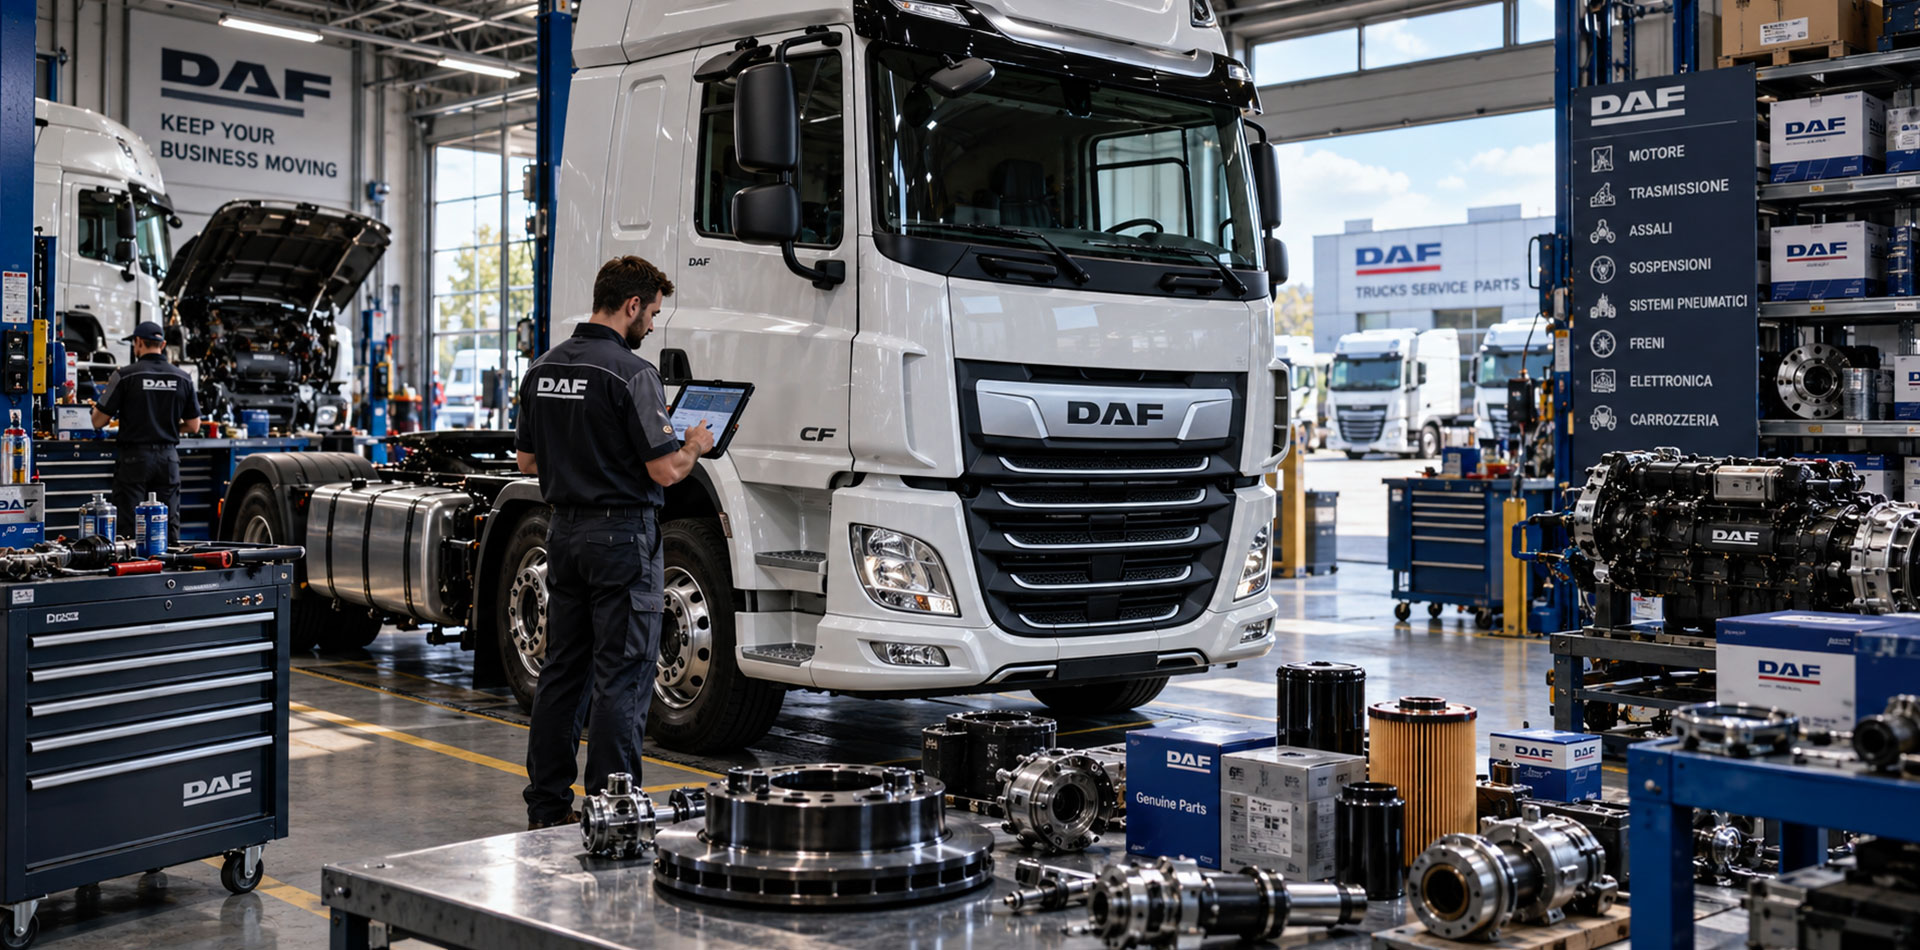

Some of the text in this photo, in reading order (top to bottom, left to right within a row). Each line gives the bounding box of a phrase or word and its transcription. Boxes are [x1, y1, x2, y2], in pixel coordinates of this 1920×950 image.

[161, 47, 332, 102] DAF
[1591, 85, 1685, 117] DAF
[160, 112, 275, 145] KEEP YOUR
[1786, 117, 1846, 136] DAF
[160, 140, 338, 178] BUSINESS MOVING
[1629, 145, 1685, 162] MOTORE
[1629, 178, 1729, 200] TRASMISSIONE
[1629, 222, 1672, 236] ASSALI
[1356, 243, 1442, 266] DAF
[1786, 241, 1848, 258] DAF
[689, 257, 711, 267] DAF
[1629, 257, 1712, 274] SOSPENSIONI
[1356, 278, 1520, 299] TRUCKS SERVICE PARTS
[1629, 294, 1748, 312] SISTEMI PNEUMATICI
[1629, 336, 1665, 350] FRENI
[142, 379, 178, 391] DAF
[537, 377, 588, 394] DAF
[1629, 374, 1713, 388] ELETTRONICA
[1067, 400, 1164, 426] DAF
[1629, 413, 1719, 427] CARROZZERIA
[800, 426, 837, 442] CF
[1711, 529, 1760, 543] DAF
[1758, 660, 1821, 678] DAF
[1166, 750, 1211, 767] DAF
[1515, 745, 1553, 758] DAF
[1574, 746, 1596, 758] DAF
[183, 770, 252, 800] DAF
[1136, 791, 1207, 816] Genuine Parts
